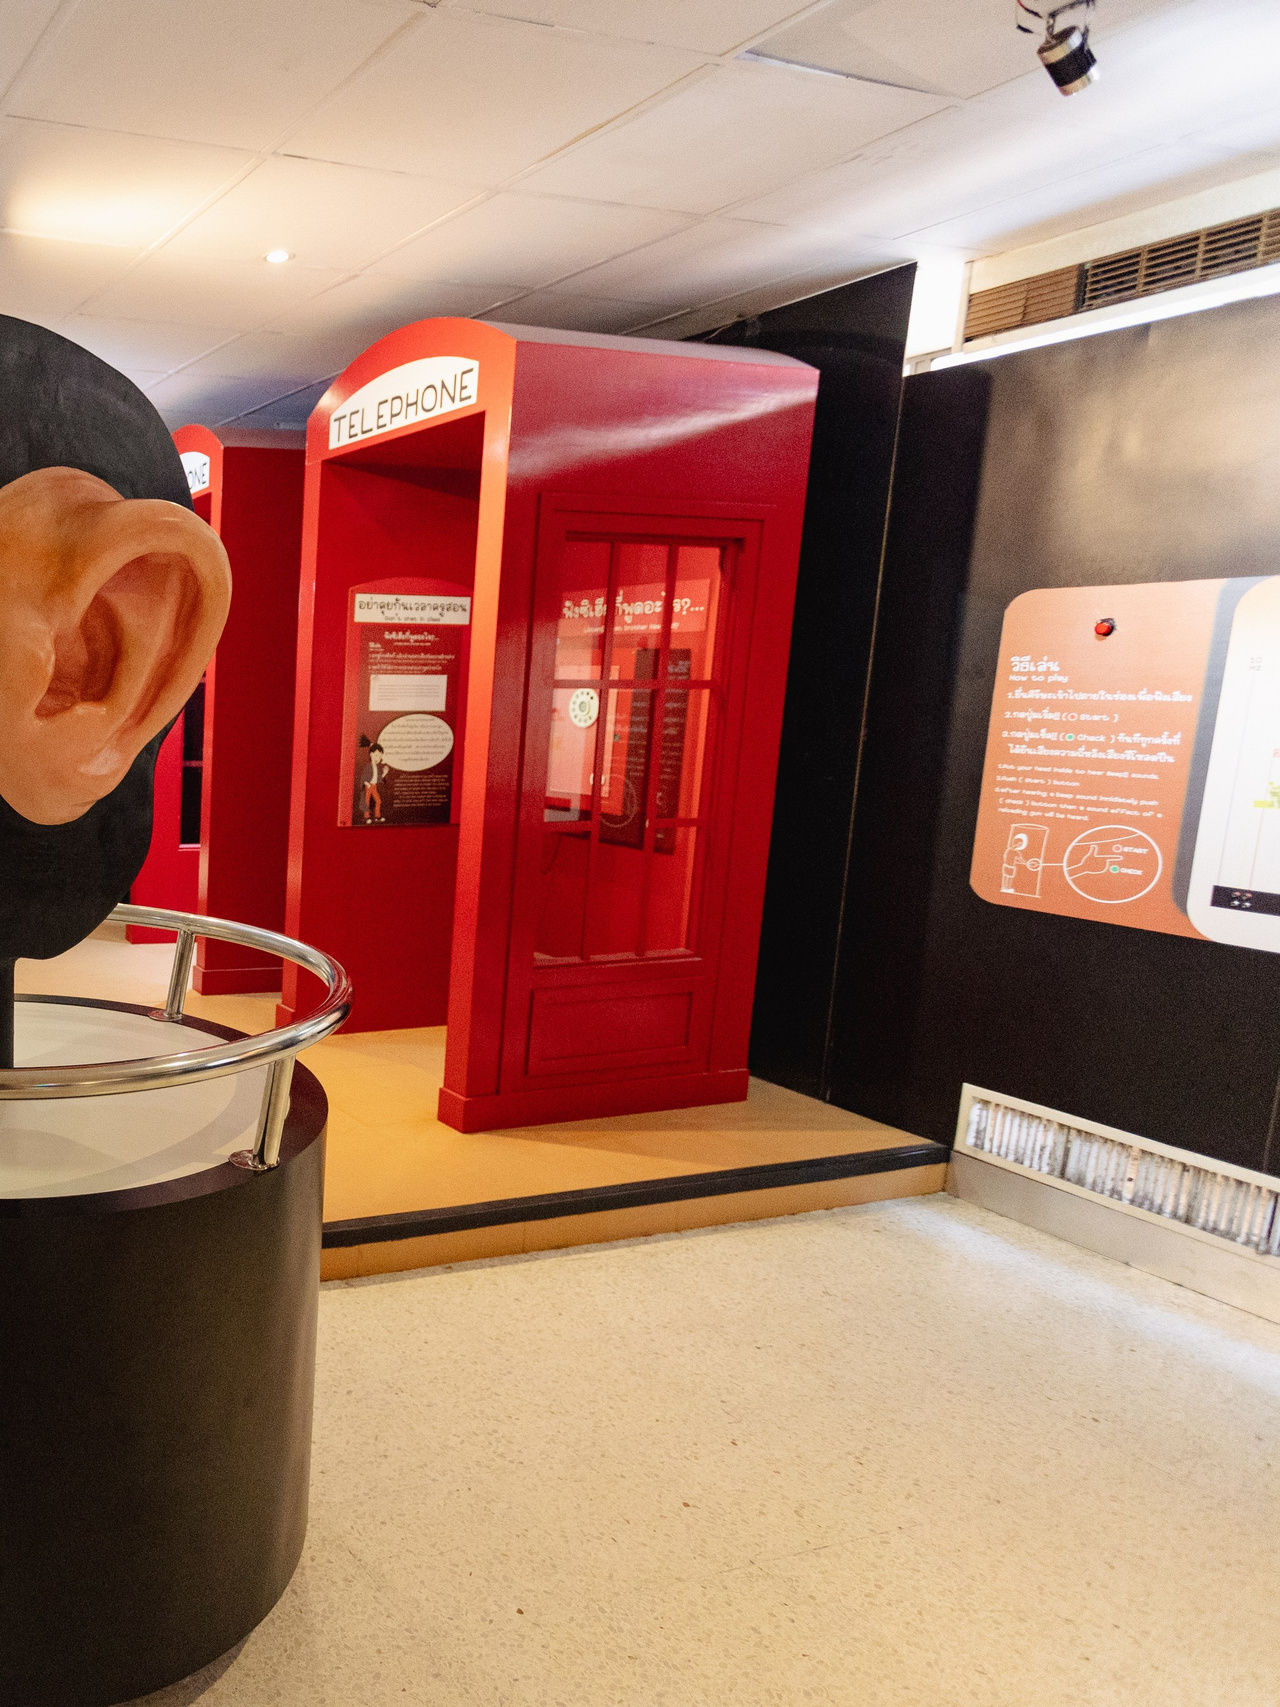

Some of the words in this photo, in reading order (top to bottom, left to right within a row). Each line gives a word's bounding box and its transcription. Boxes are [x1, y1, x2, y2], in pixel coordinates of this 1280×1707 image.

[333, 367, 474, 442] TELEPHONE
[358, 597, 468, 617] อย่าคุยกันเวลาครูสอน
[1010, 655, 1060, 672] วิธีเล่น
[1008, 674, 1028, 682] How
[1047, 674, 1069, 683] play
[1079, 713, 1110, 721] Start
[1077, 733, 1106, 742] Check
